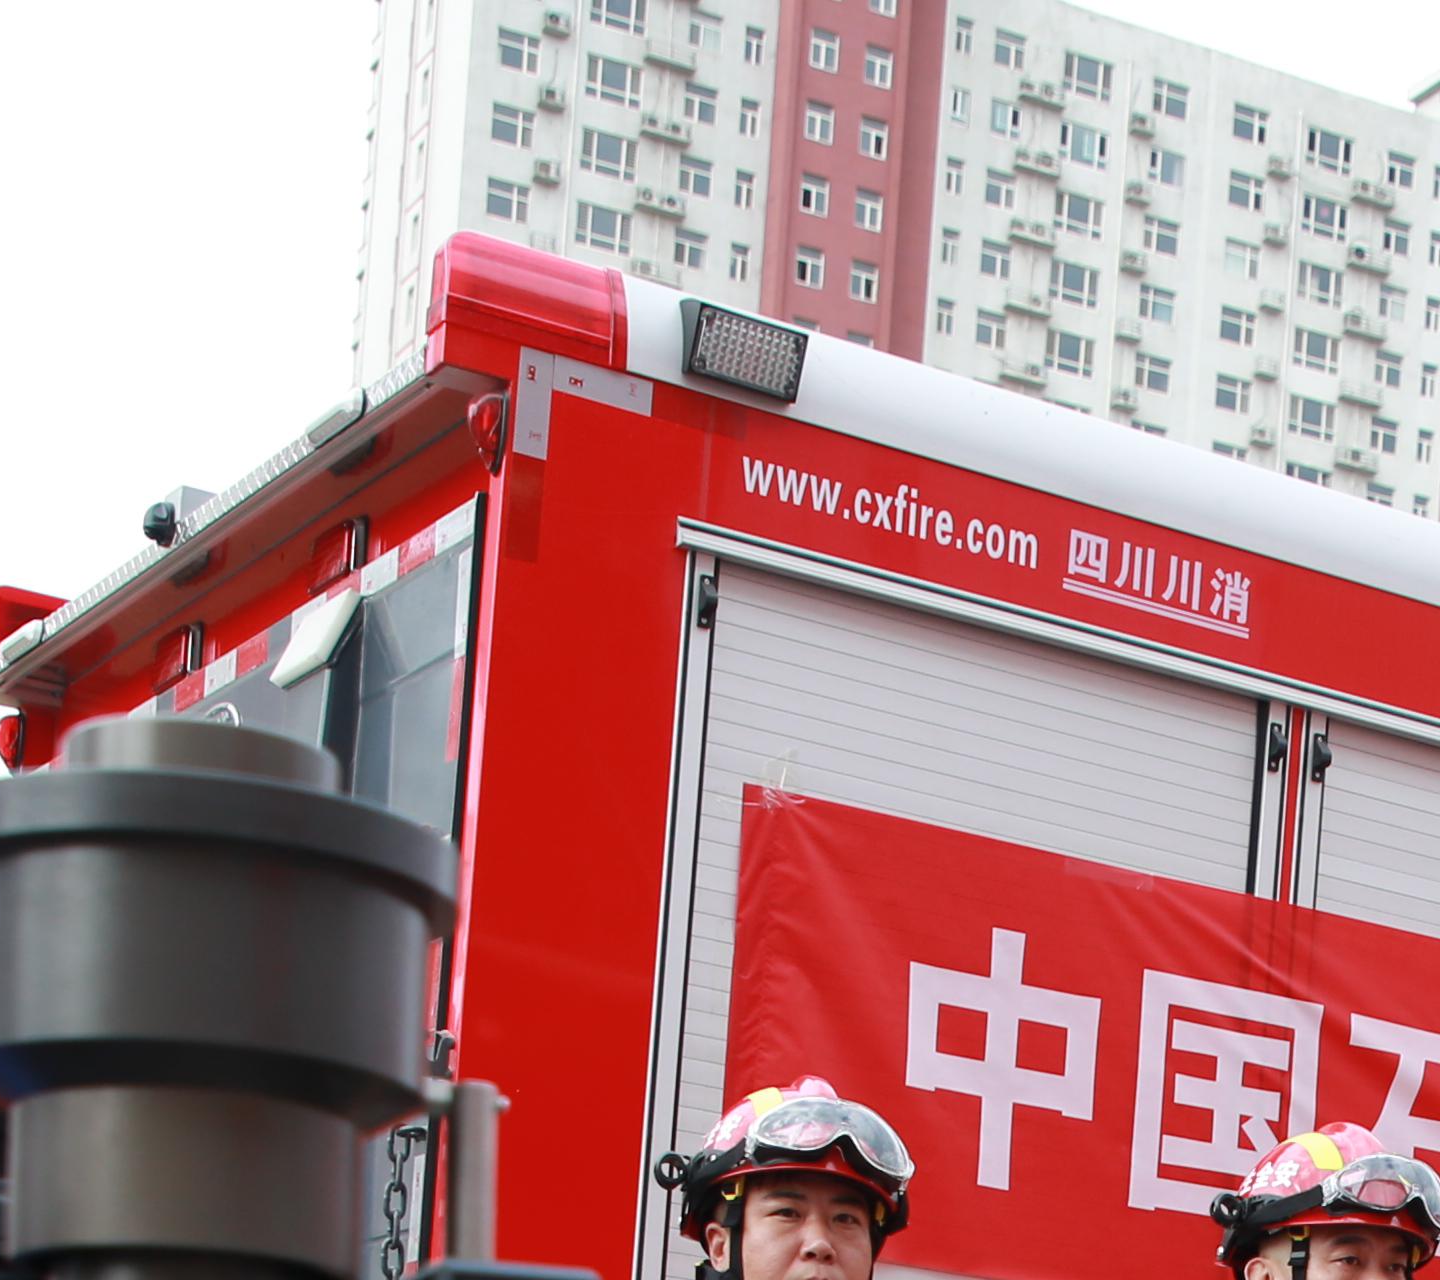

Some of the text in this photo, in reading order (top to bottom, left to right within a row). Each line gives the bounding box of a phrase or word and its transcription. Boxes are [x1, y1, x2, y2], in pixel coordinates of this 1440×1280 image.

[742, 455, 1039, 568] www.cxfire.com
[1067, 528, 1250, 625] 四川川消
